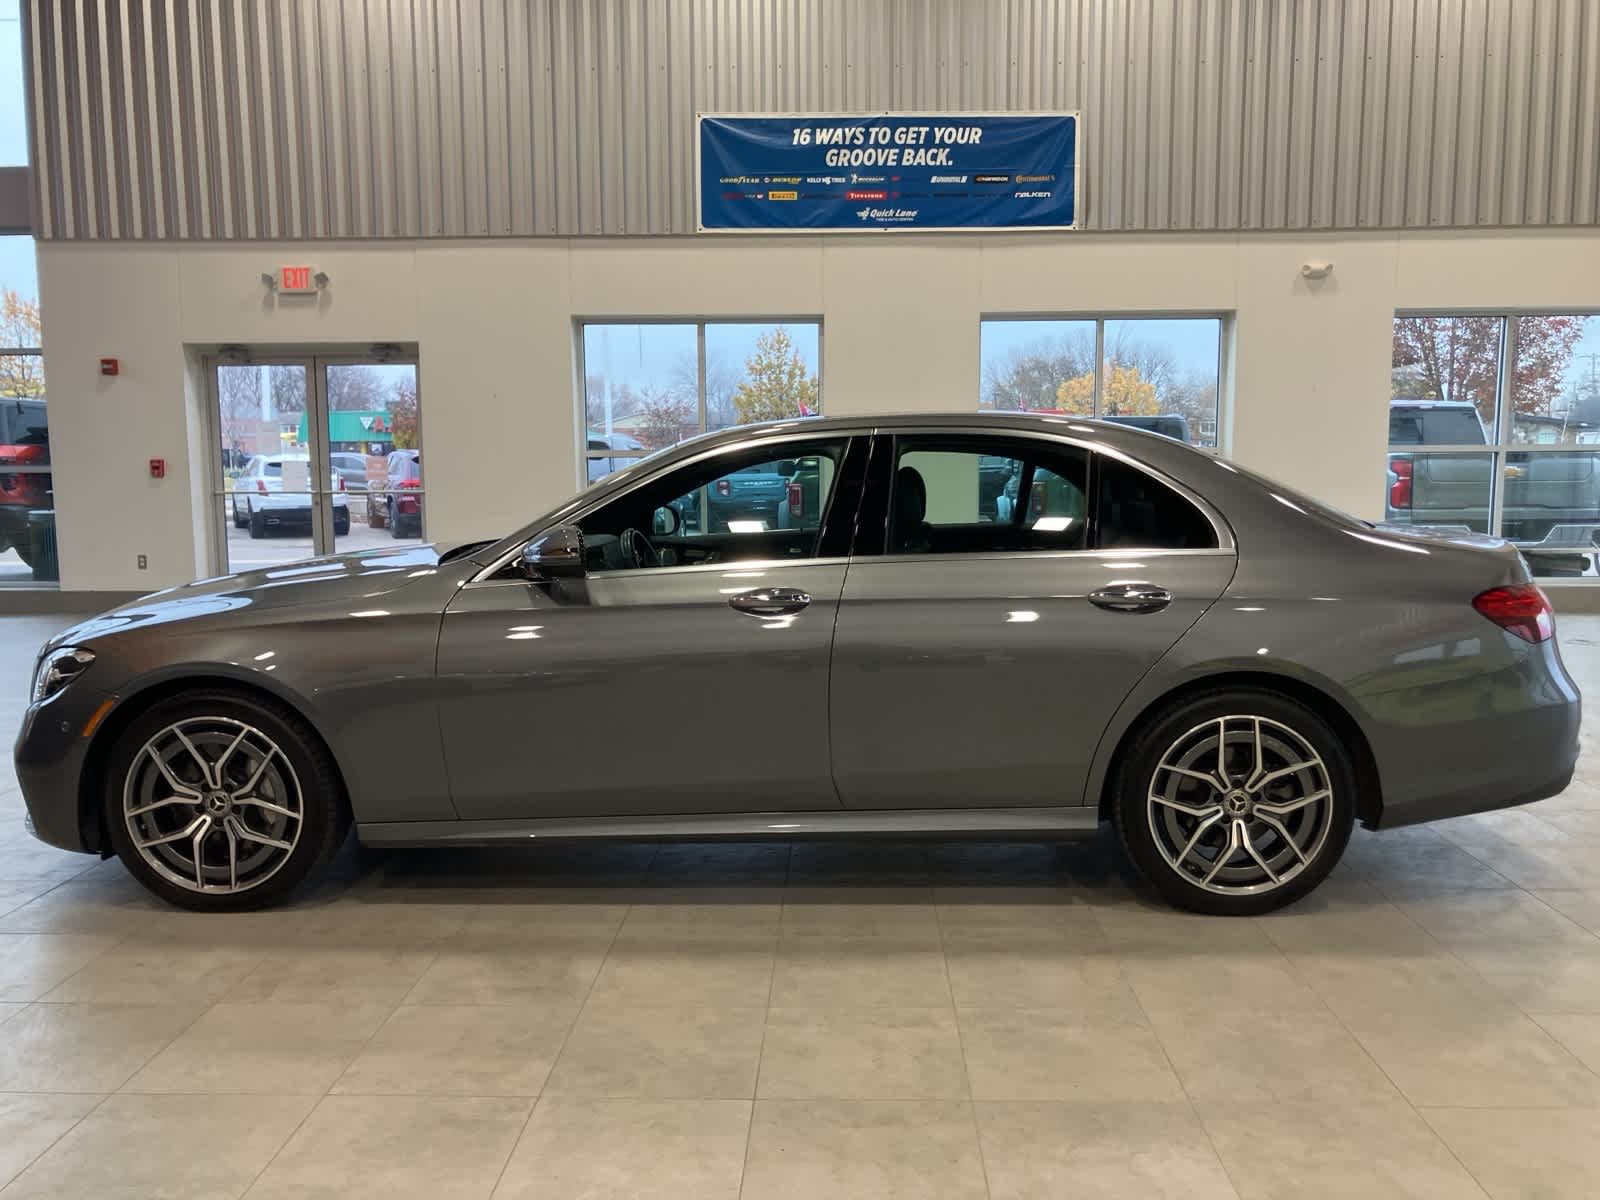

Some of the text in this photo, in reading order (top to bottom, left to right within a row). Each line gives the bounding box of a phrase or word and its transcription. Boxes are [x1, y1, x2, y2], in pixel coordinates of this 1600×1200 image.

[792, 127, 982, 145] 16 WAYS TO GET YOUR
[825, 148, 953, 166] GROOVE BACK.
[870, 209, 919, 218] Quick Lane
[282, 267, 310, 288] EXIT
